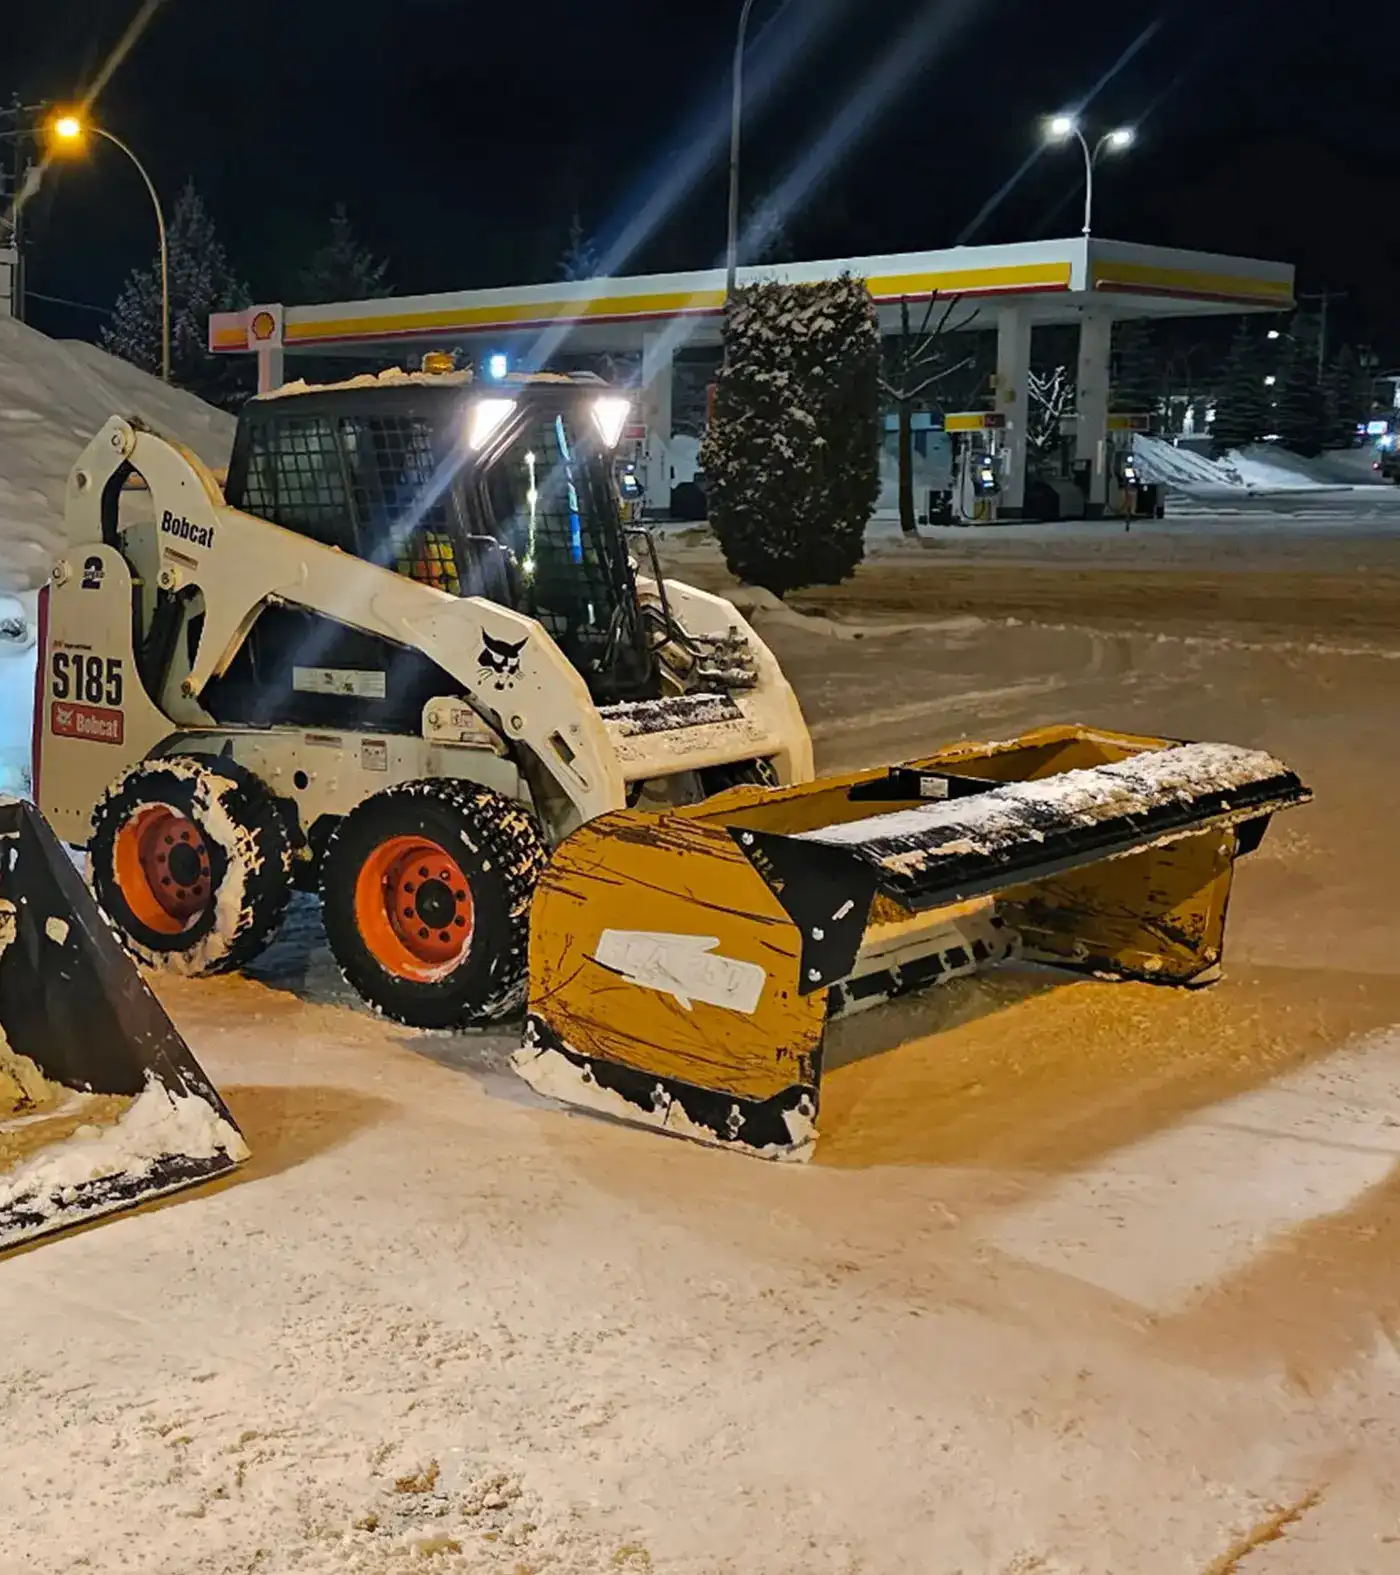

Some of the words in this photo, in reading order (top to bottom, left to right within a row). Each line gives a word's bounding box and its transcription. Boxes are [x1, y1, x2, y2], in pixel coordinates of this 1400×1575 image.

[161, 510, 214, 548] Bobcat
[81, 556, 103, 589] 2
[52, 652, 122, 706] S185
[76, 713, 118, 738] Bobcat
